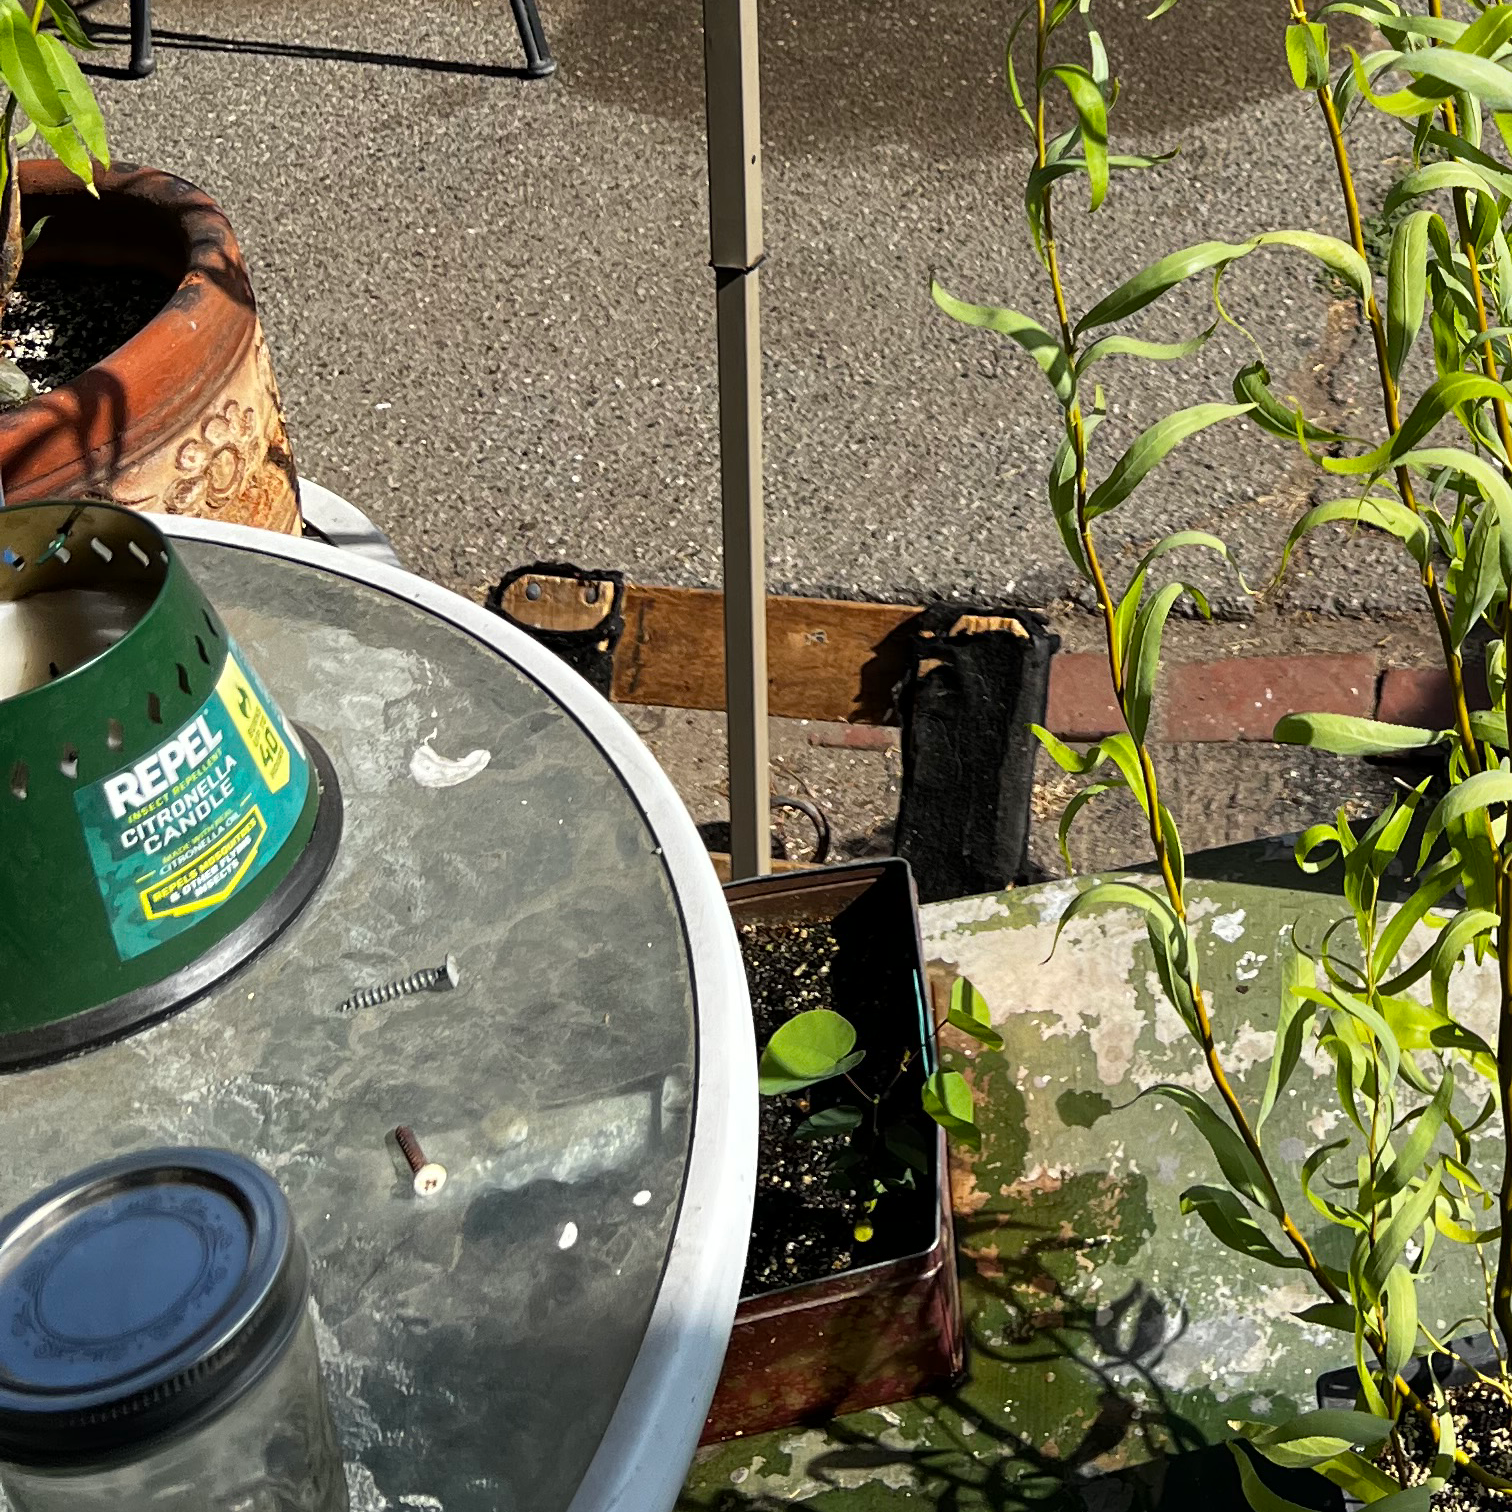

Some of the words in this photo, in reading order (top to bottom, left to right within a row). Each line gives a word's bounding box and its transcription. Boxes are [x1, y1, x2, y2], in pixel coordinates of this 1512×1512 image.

[103, 714, 223, 819] REPEL
[259, 726, 278, 767] 40
[120, 754, 237, 848] CITRONELLA
[127, 793, 169, 824] INSECT
[172, 747, 222, 796] REPELLENT
[143, 777, 235, 856] CANDLE
[159, 825, 225, 875] CITRONELLA
[152, 868, 198, 903] REPELS
[182, 864, 219, 896] OTHER
[194, 857, 239, 899] INSECTS
